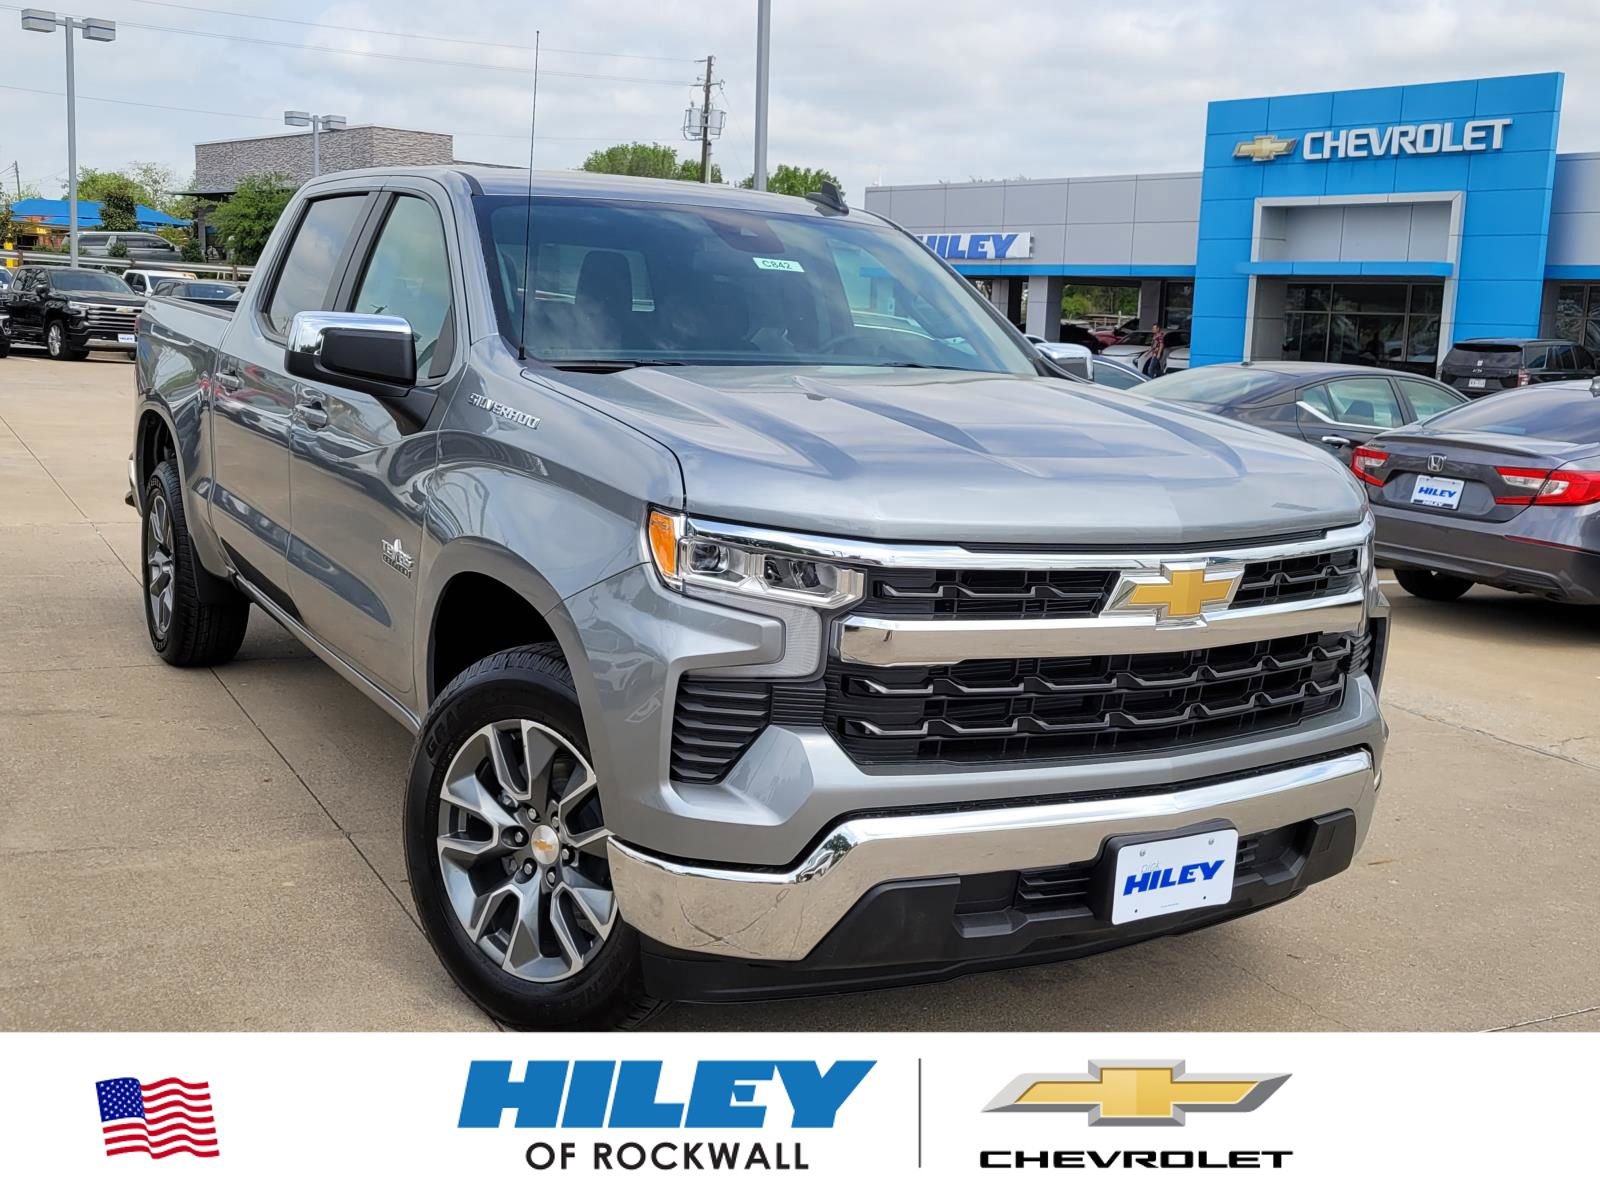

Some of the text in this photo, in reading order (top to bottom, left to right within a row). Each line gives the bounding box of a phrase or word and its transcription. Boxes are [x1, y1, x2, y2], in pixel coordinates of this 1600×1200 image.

[1303, 119, 1512, 160] CHEVROLET
[916, 233, 1019, 259] ILEY
[762, 260, 792, 270] C842
[469, 393, 540, 429] SILVERADO
[1418, 486, 1457, 498] HILEY
[1123, 859, 1225, 896] HILEY
